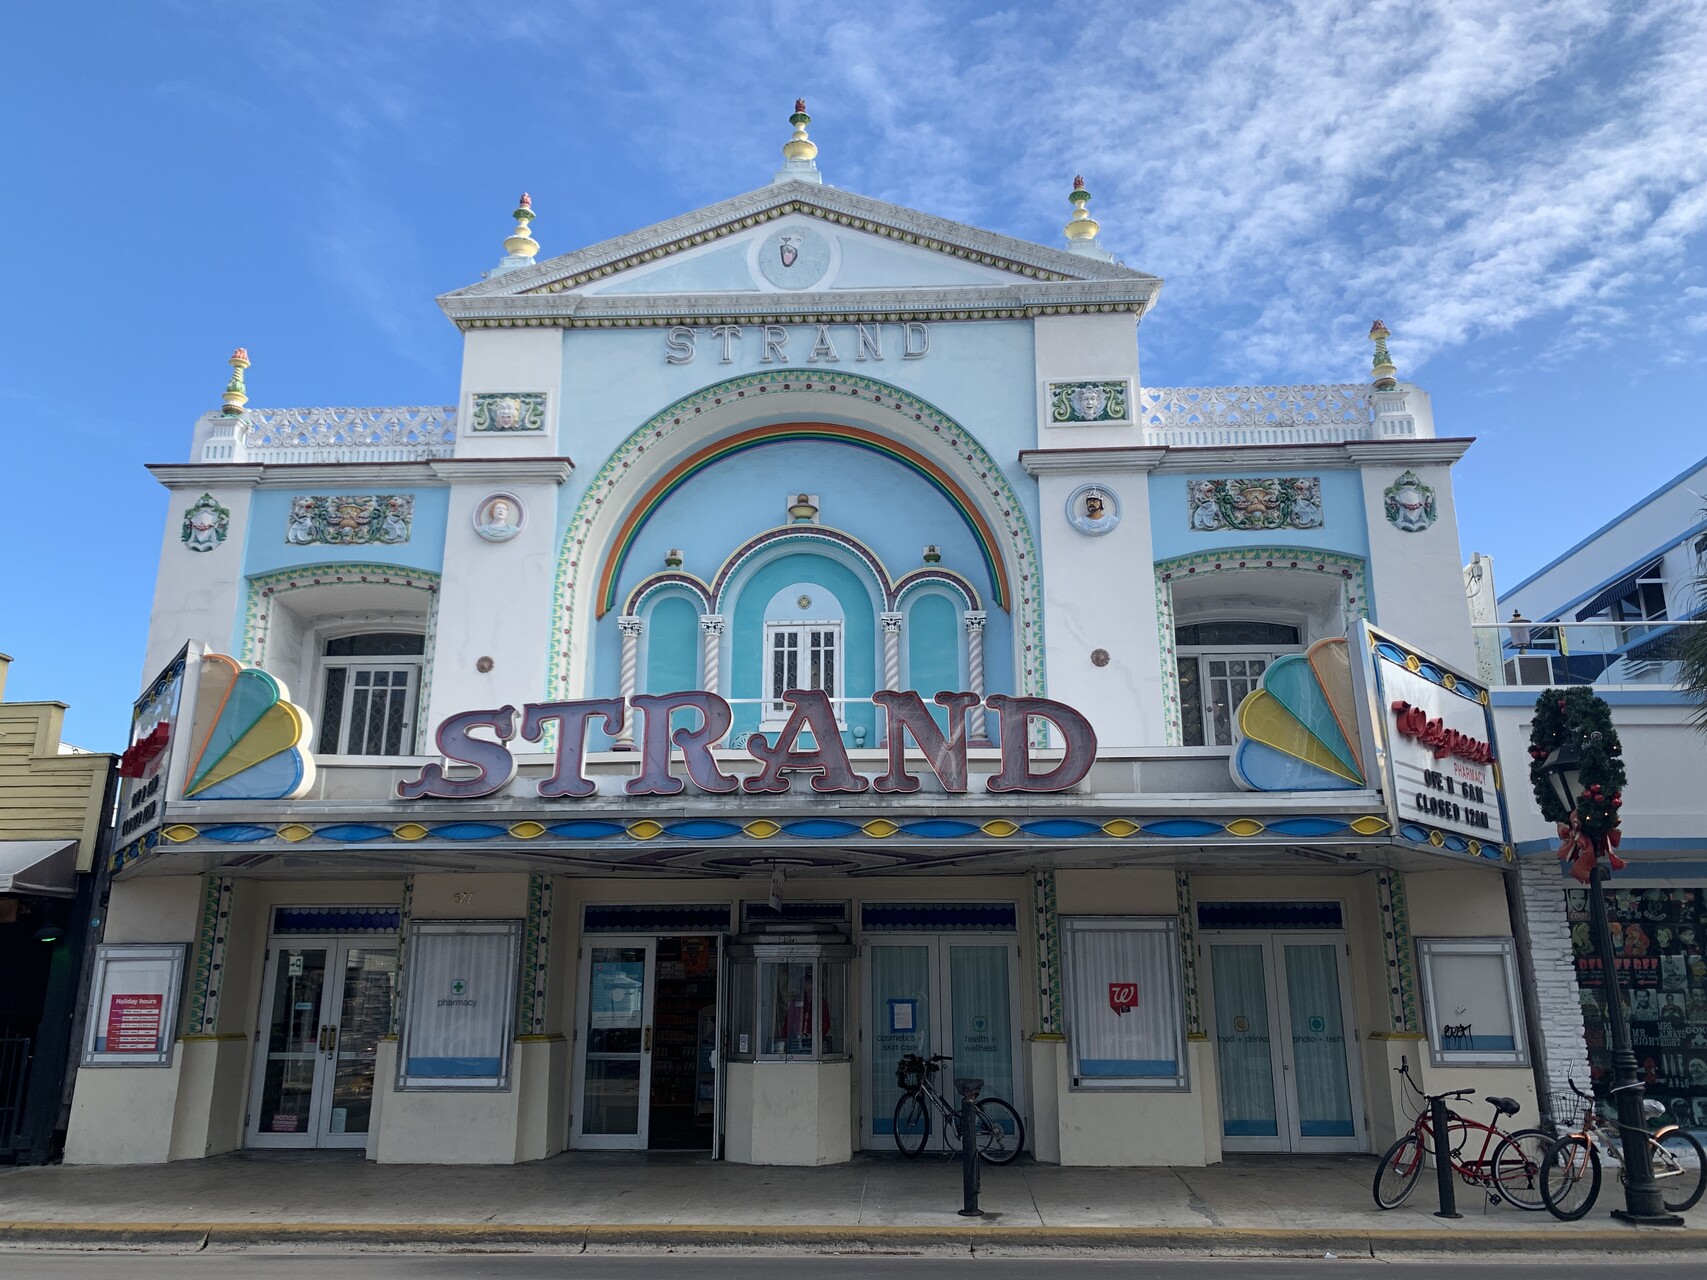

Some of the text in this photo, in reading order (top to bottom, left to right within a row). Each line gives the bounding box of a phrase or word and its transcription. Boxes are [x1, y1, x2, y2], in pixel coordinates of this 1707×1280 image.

[665, 323, 931, 364] STRAND
[395, 689, 1098, 799] STRAND
[1453, 762, 1486, 785] PHARMACY
[1462, 781, 1484, 803] 6AM
[1415, 792, 1489, 828] CLOSED 12AM
[437, 998, 478, 1008] pharmacy
[1632, 1028, 1649, 1037] MR.
[1685, 1026, 1707, 1035] GOK
[876, 1034, 916, 1042] cosmetics
[964, 1035, 989, 1043] health
[1217, 1035, 1235, 1043] food
[1293, 1035, 1316, 1044] photo
[1326, 1035, 1345, 1043] tech
[882, 1043, 899, 1051] skin
[964, 1044, 998, 1052] wellness
